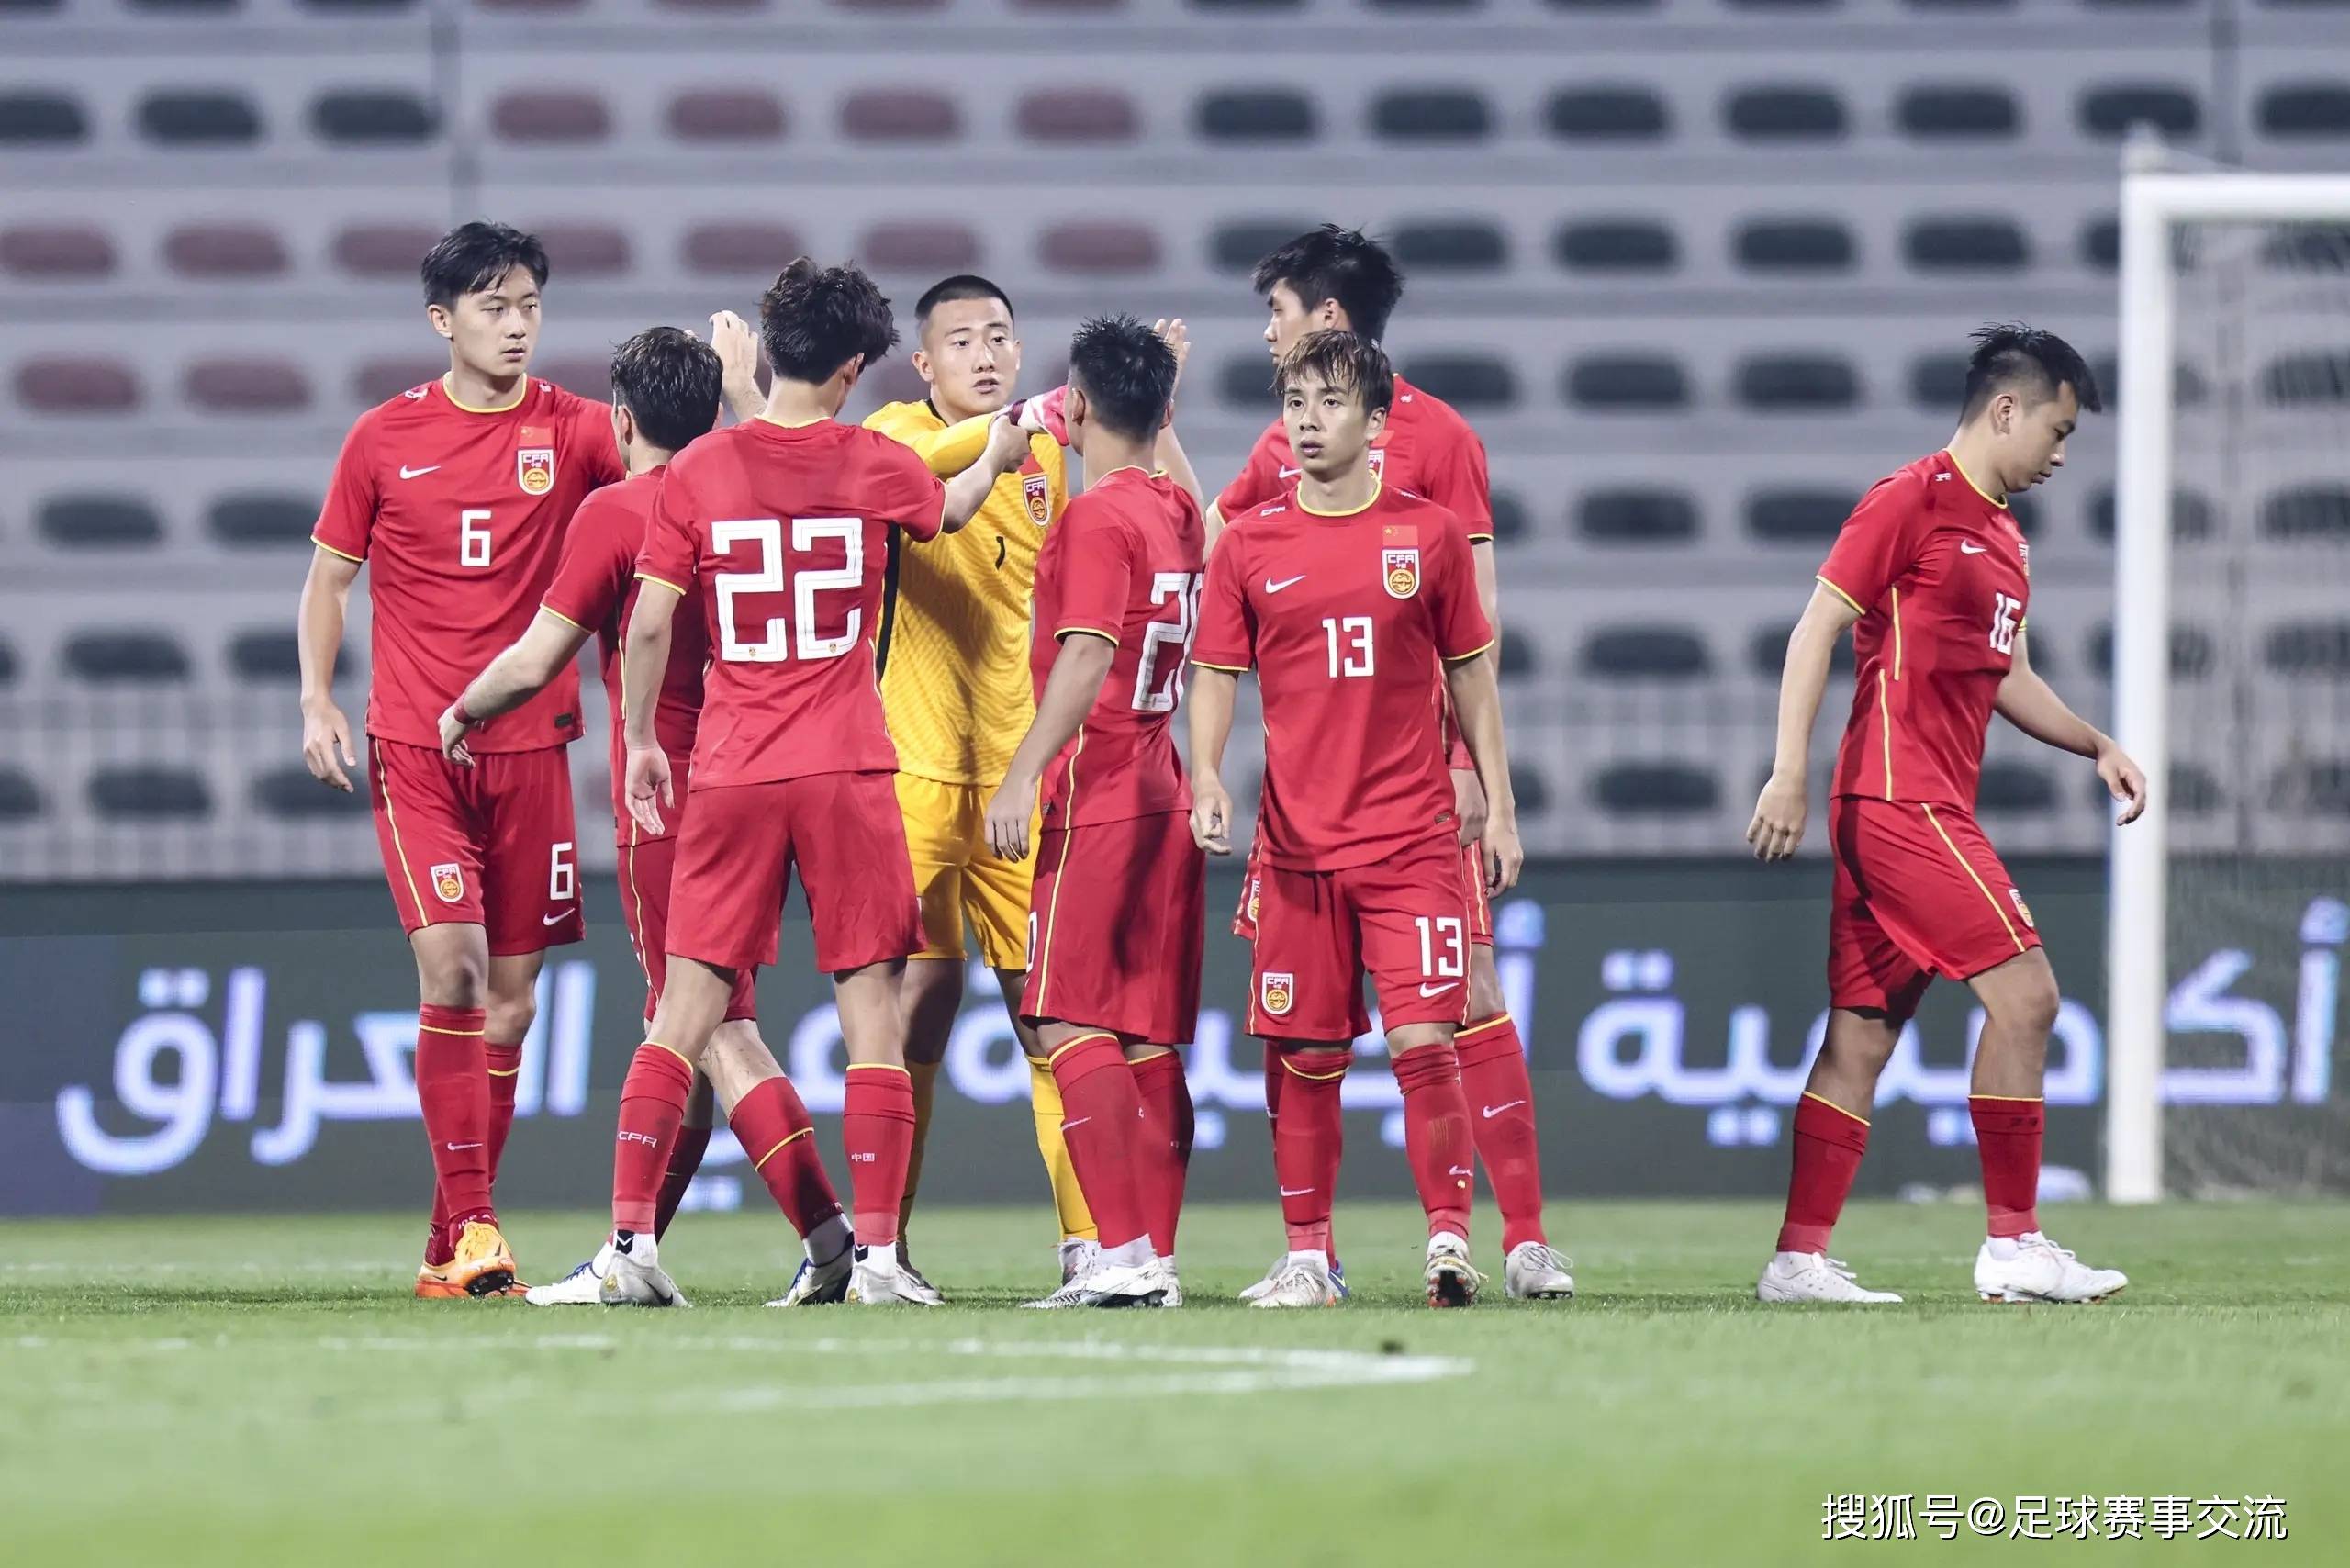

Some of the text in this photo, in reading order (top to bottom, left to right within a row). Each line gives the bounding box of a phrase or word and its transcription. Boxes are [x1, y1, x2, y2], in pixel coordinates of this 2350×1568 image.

[522, 454, 549, 464] CFA
[1025, 480, 1045, 493] CFA
[461, 510, 492, 566] 6
[995, 536, 1006, 570] 1
[1387, 554, 1415, 564] CFA
[711, 517, 864, 663] 22
[1989, 592, 2022, 655] 16
[1322, 616, 1375, 678] 13
[550, 842, 574, 901] 6
[1415, 916, 1464, 977] 13
[1267, 977, 1289, 985] CFA
[618, 1131, 657, 1148] CFA
